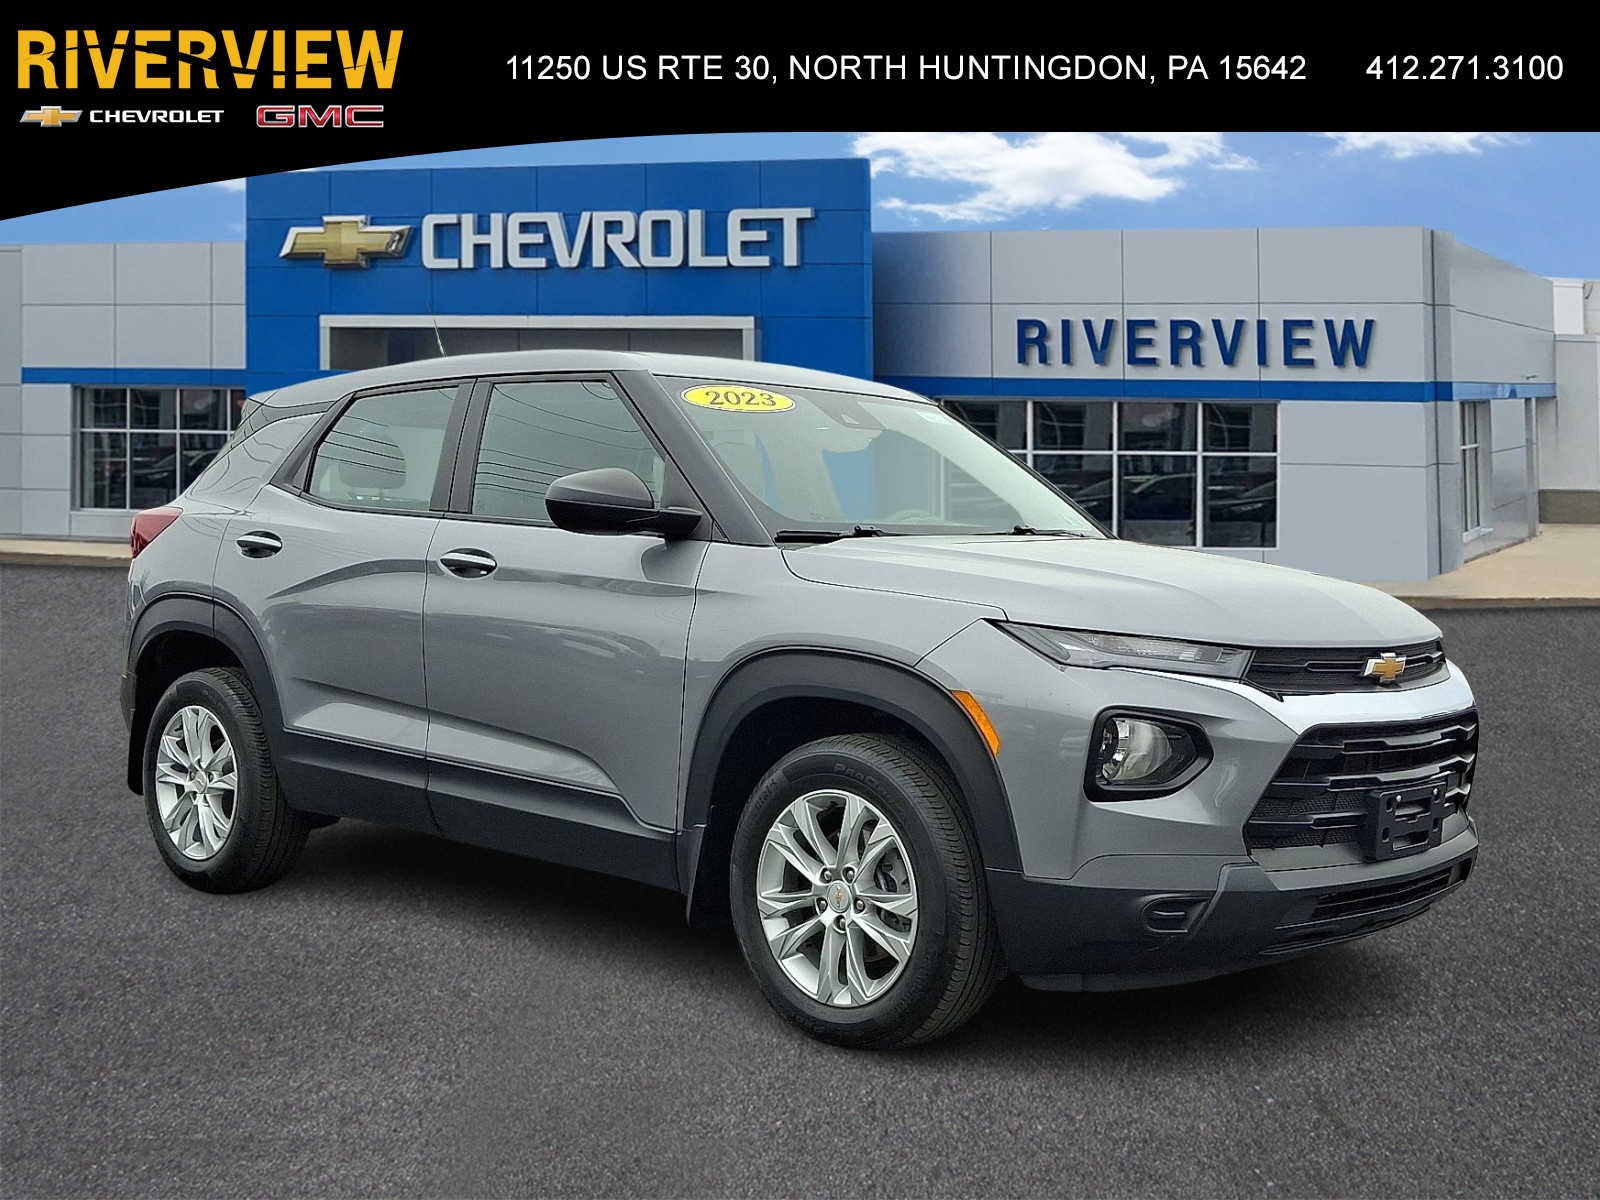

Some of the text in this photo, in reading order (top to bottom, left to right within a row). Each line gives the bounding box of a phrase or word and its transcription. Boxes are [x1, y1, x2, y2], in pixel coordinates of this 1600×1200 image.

[421, 207, 815, 270] CHEVROLET
[1016, 318, 1376, 368] RIVERVIEW
[704, 389, 777, 408] 2023
